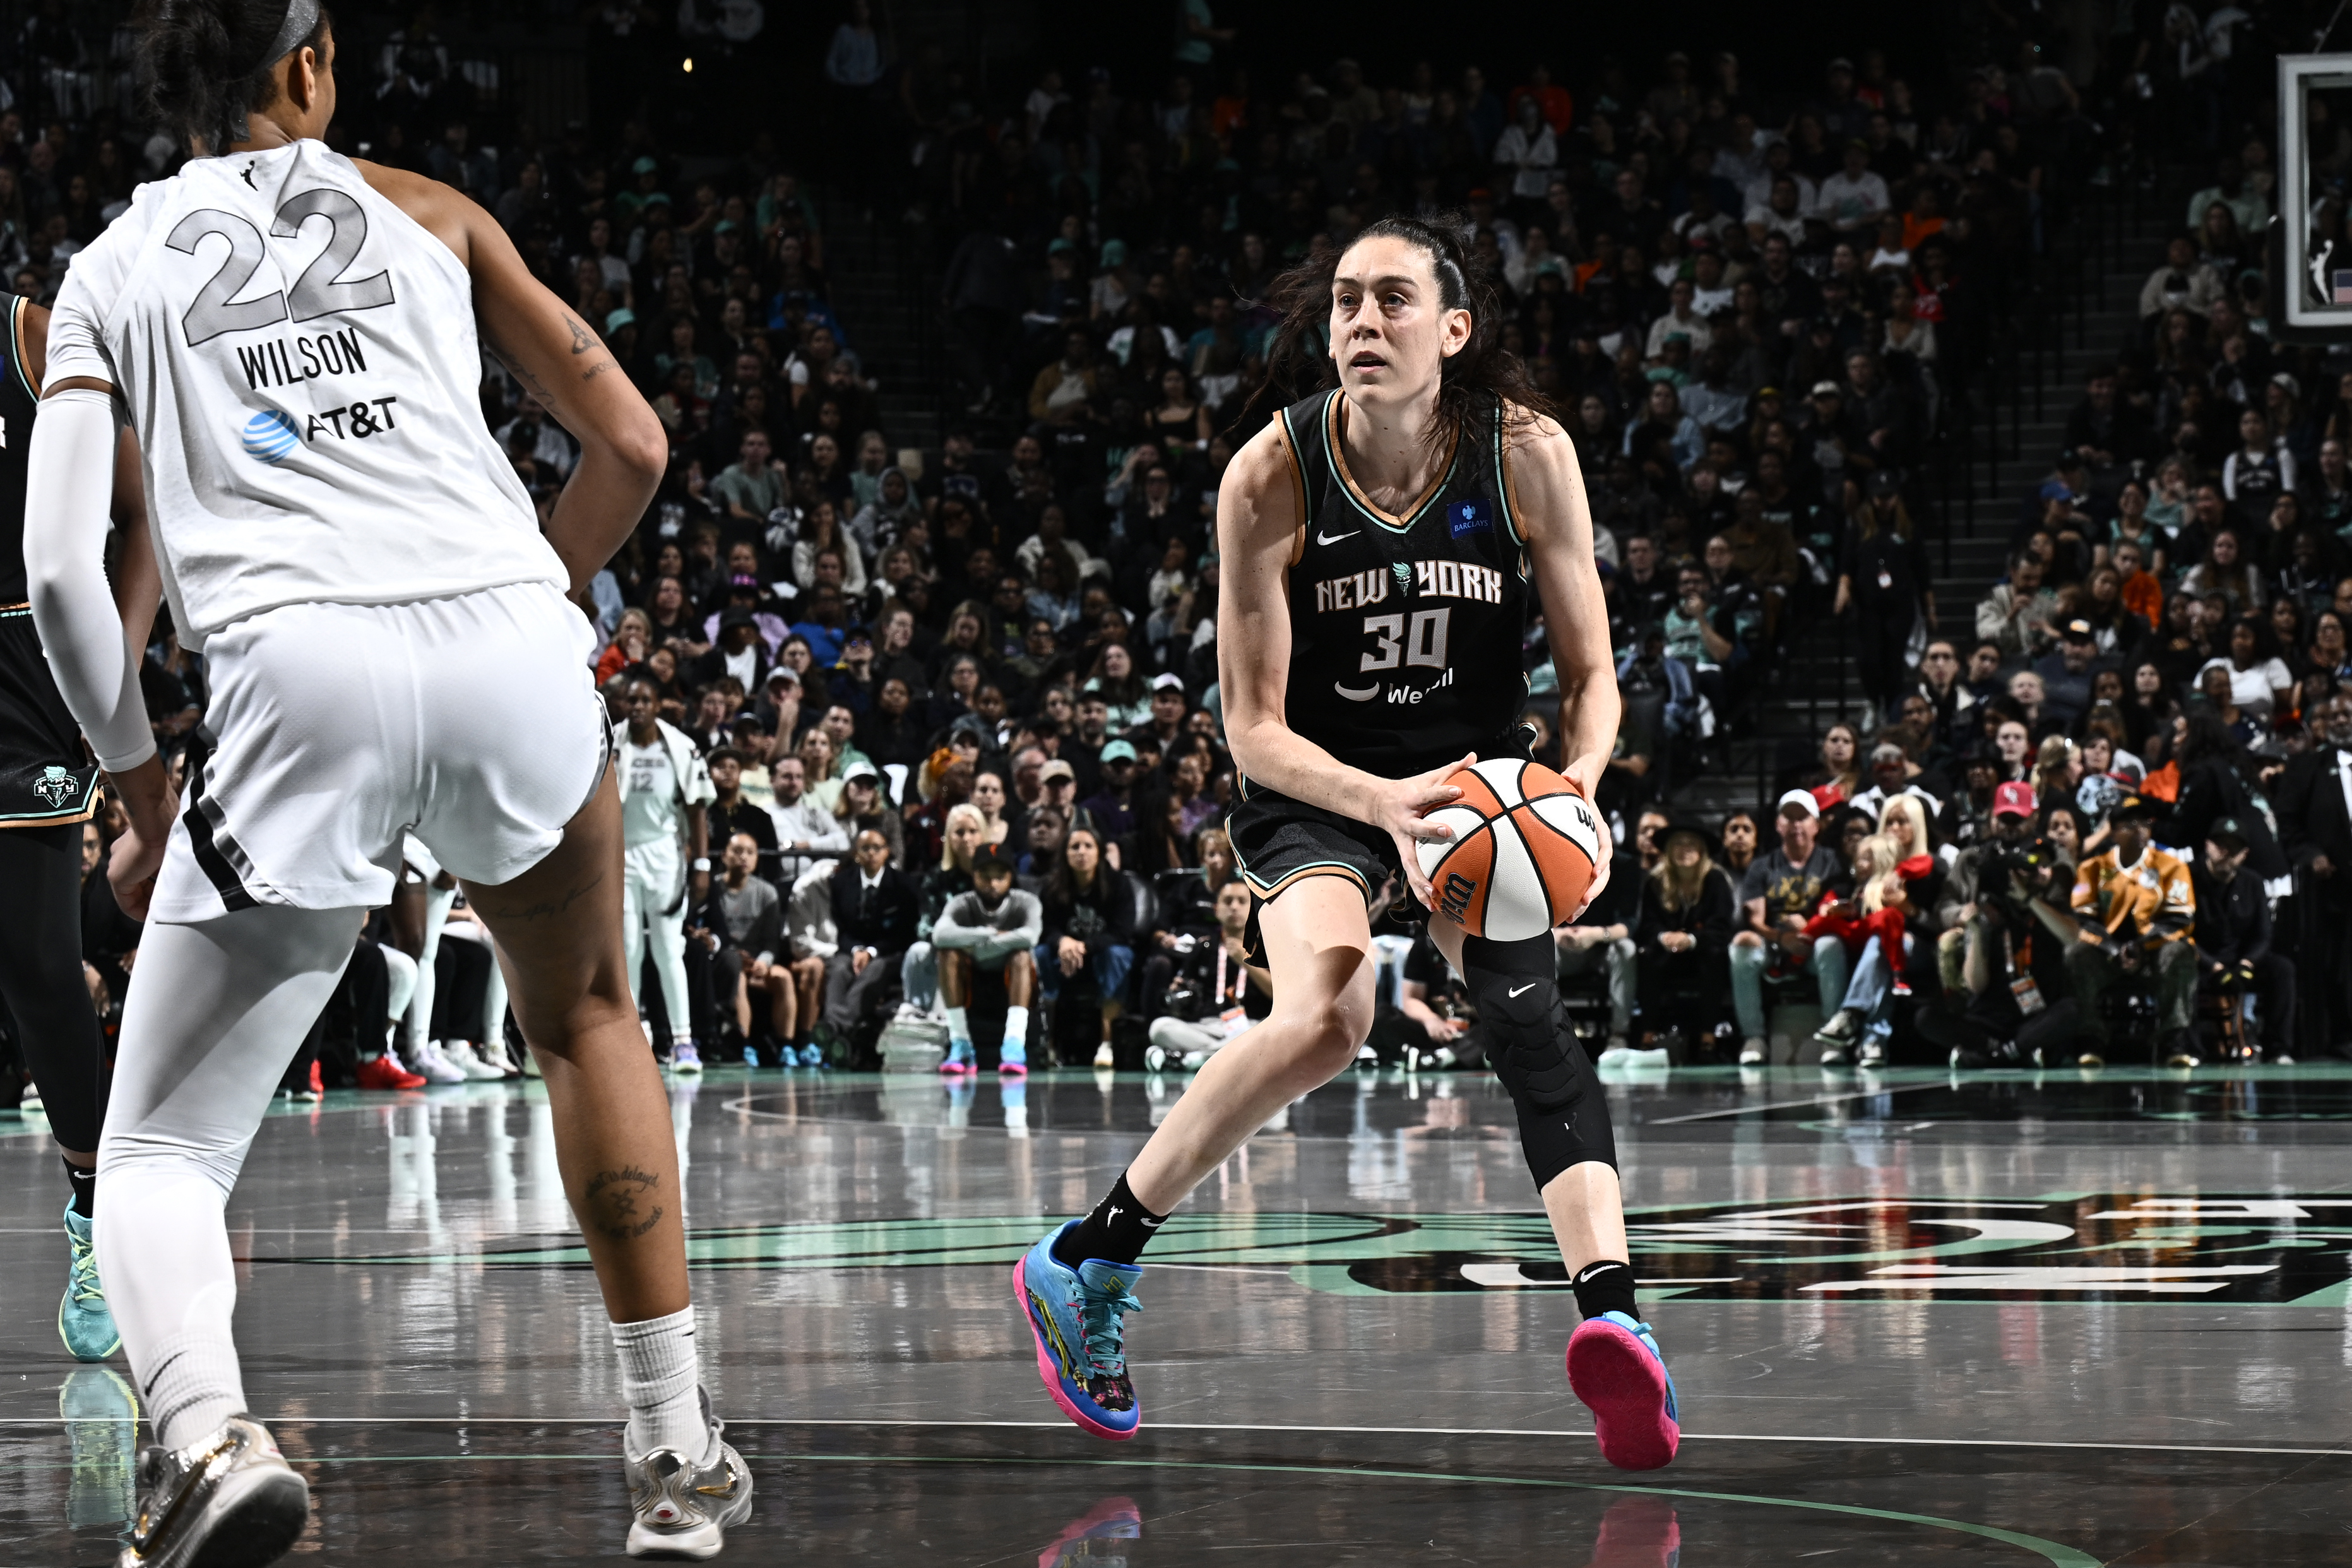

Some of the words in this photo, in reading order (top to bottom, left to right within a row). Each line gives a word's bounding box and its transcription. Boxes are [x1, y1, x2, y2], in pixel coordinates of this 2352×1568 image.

[165, 187, 396, 347] 22
[236, 327, 367, 391] WILSON
[307, 396, 397, 442] AT&T
[1454, 520, 1488, 532] BARCLAYS
[1314, 567, 1389, 614] NEW
[1414, 559, 1503, 605] YORK
[1359, 606, 1452, 674] 30
[621, 1165, 659, 1192] delayed
